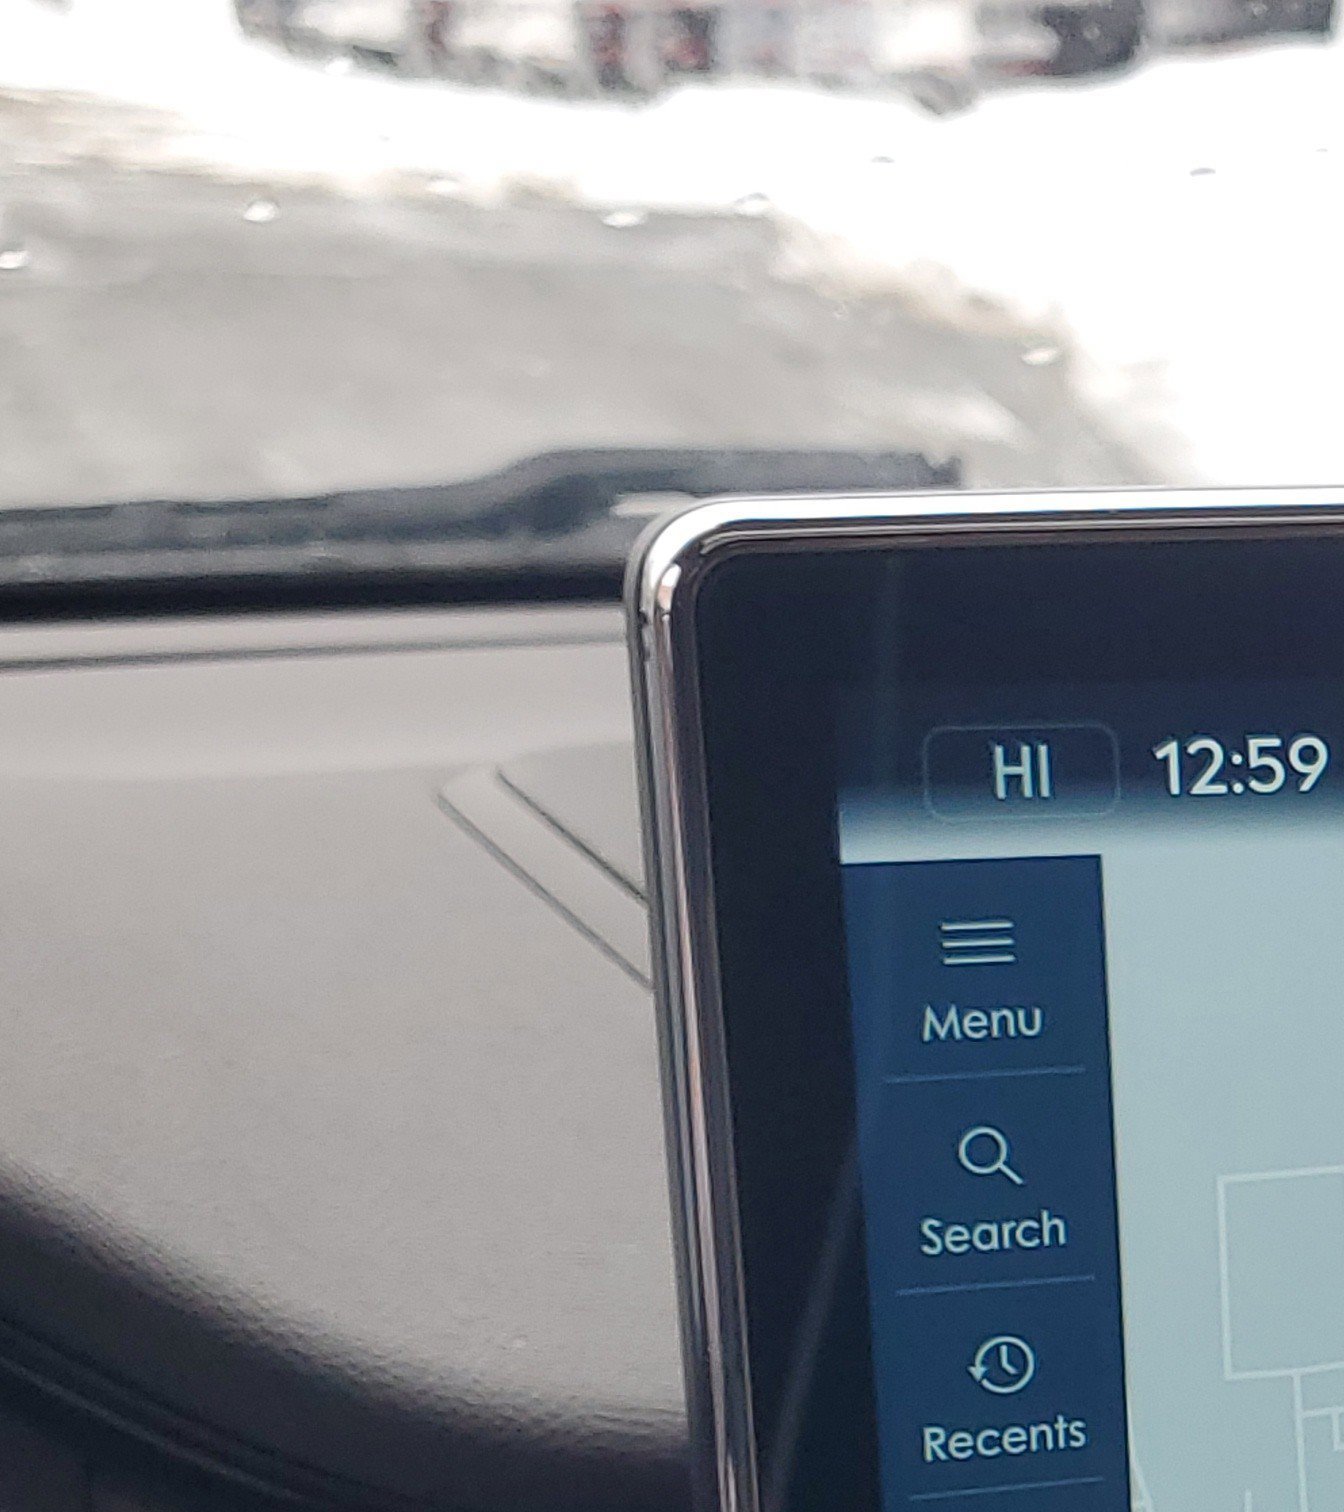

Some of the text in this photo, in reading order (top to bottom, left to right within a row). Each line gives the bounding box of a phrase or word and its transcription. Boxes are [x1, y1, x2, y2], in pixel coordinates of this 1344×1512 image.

[993, 743, 1050, 799] HI
[1153, 736, 1329, 795] 12:59
[921, 1005, 1043, 1042] Menu
[920, 1211, 1068, 1255] Search
[923, 1415, 1087, 1463] Recents
